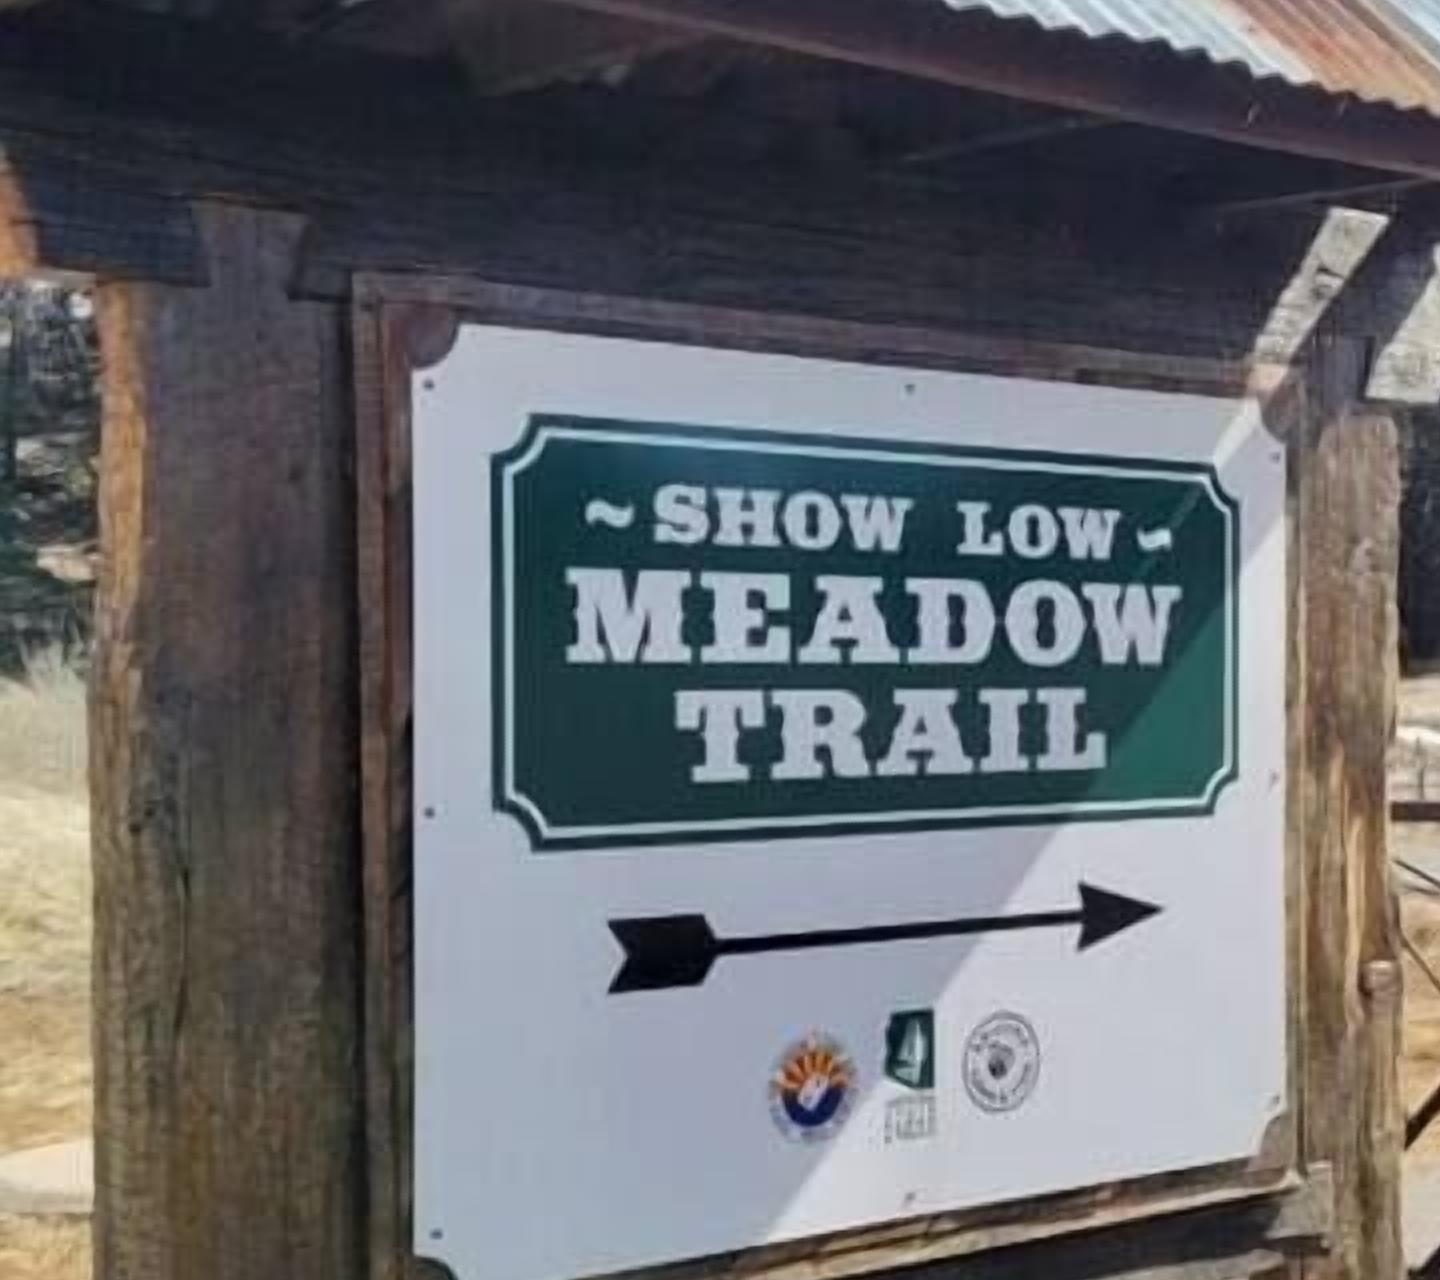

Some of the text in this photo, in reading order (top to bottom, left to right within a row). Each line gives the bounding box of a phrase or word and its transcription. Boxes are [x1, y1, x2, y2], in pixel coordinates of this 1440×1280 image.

[653, 484, 1121, 560] SHOW LOW
[565, 567, 1182, 668] MEADOW
[675, 687, 1107, 783] TRAIL
